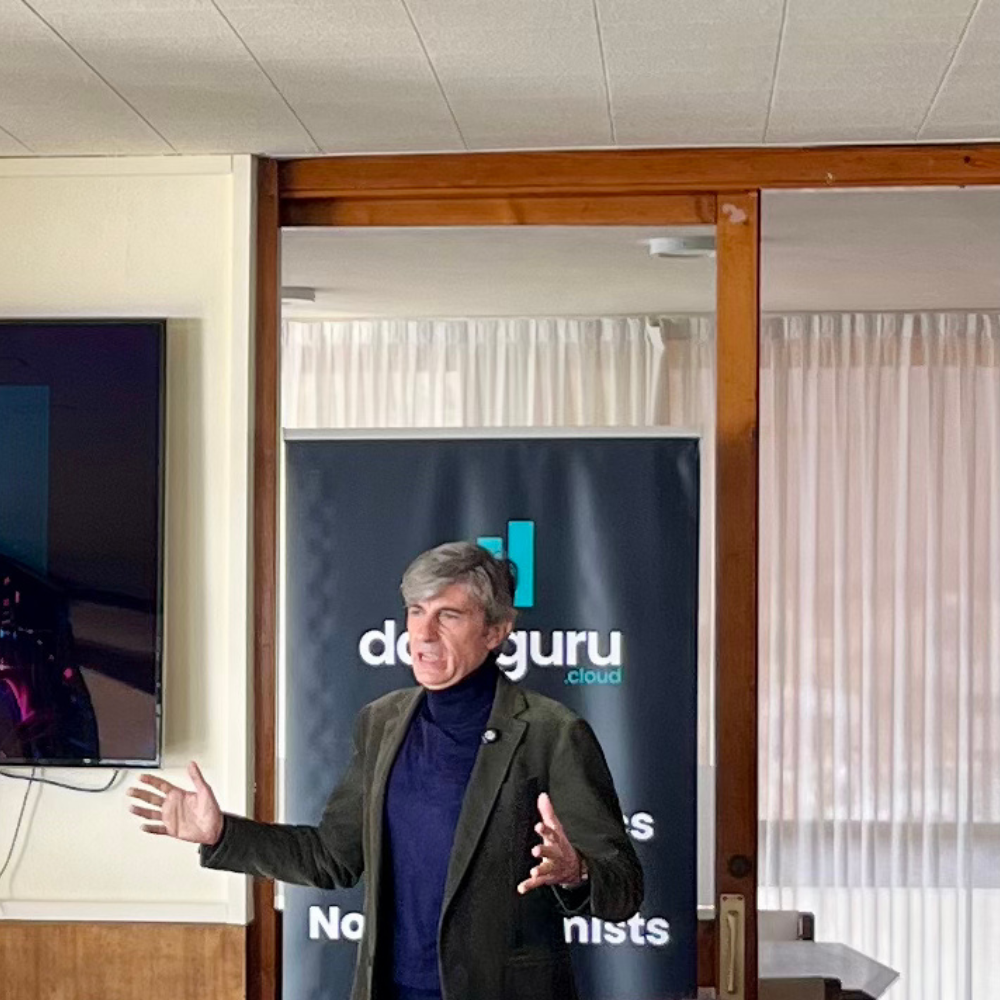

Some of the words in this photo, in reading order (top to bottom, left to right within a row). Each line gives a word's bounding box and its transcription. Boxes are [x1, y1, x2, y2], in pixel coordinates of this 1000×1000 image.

[359, 620, 621, 681] dguru
[564, 667, 621, 684] .cloud
[563, 912, 670, 946] nists
